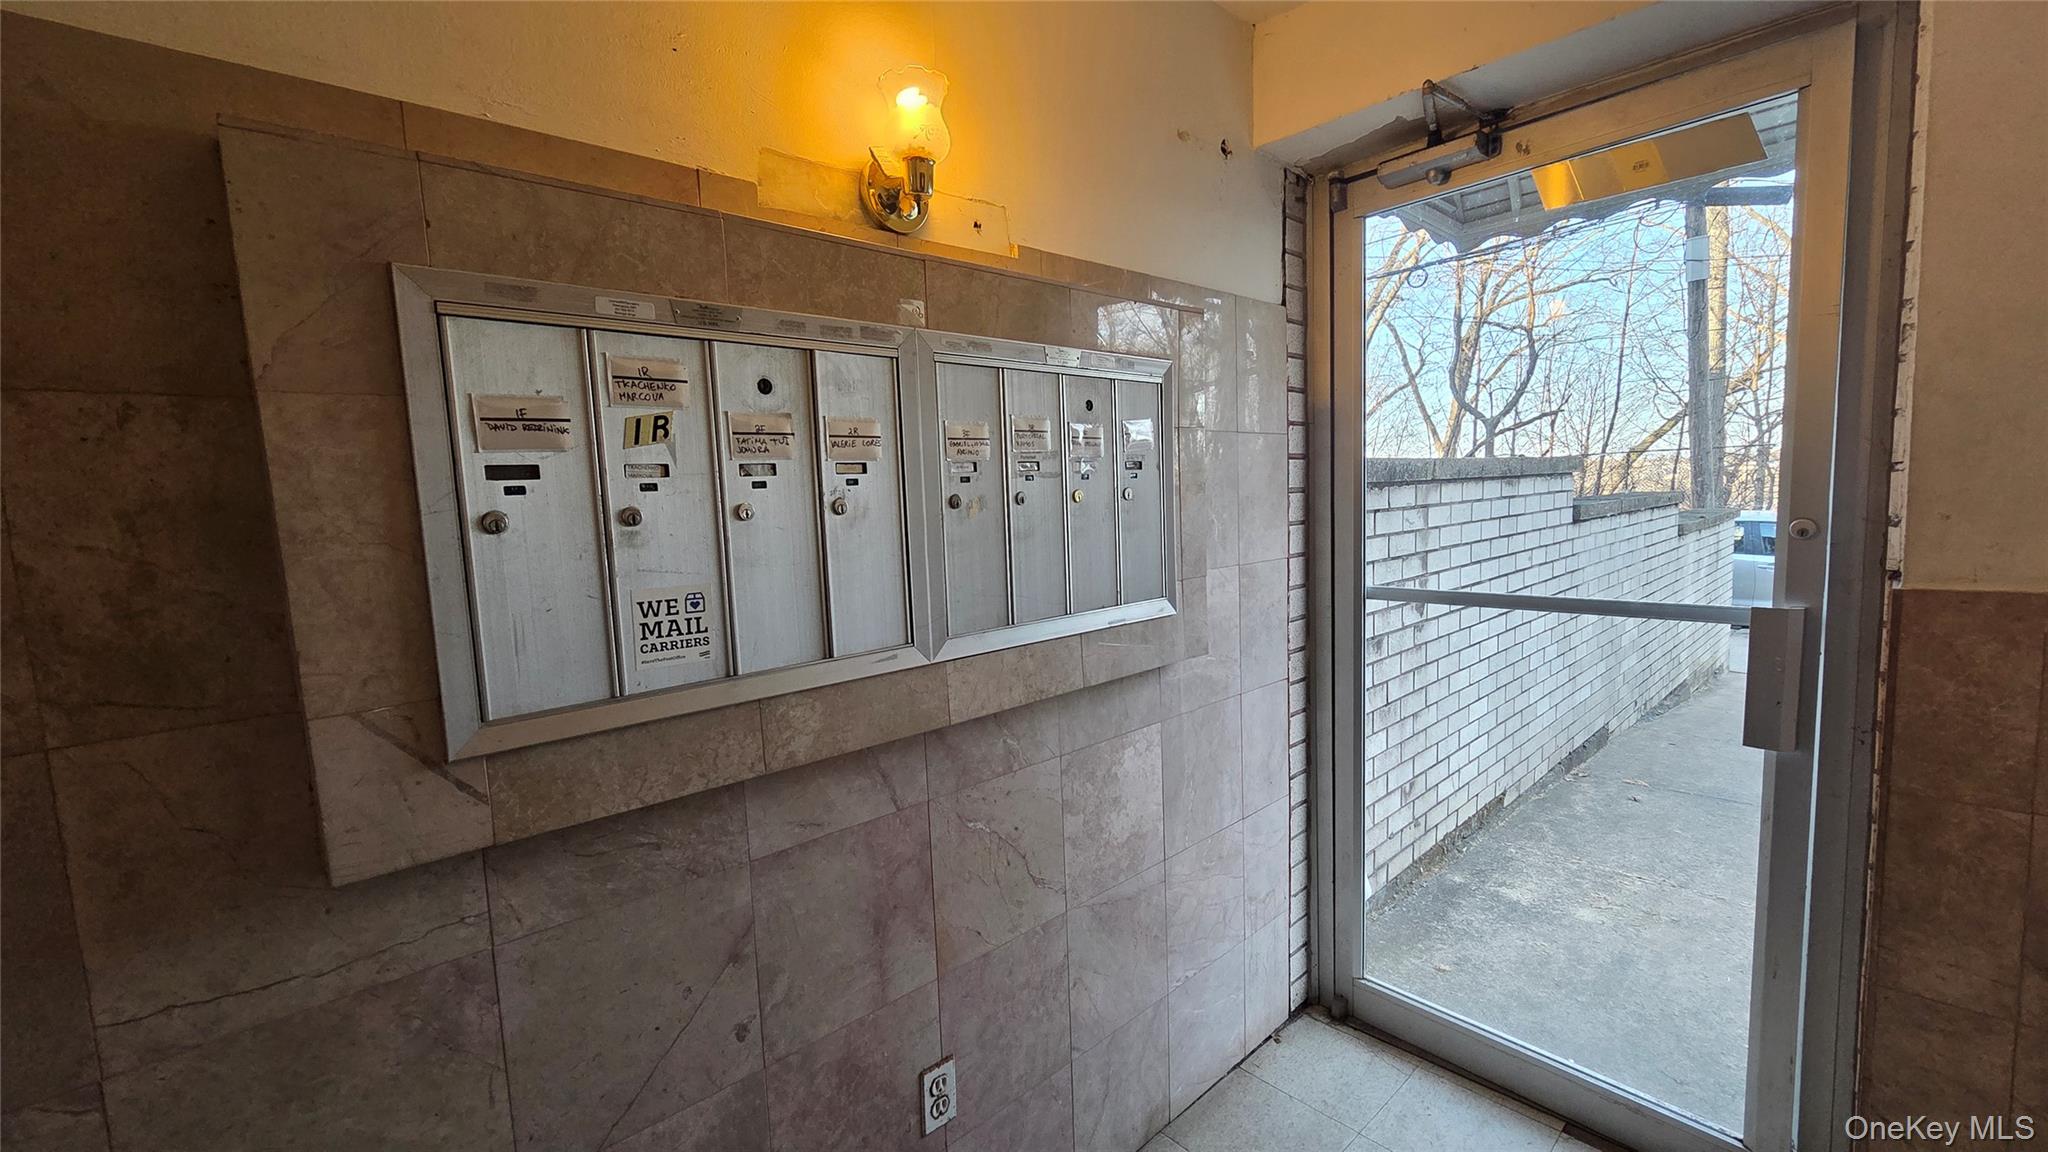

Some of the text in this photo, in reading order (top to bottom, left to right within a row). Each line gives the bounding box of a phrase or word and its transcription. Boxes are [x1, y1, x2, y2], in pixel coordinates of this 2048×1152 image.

[614, 381, 677, 391] TKACHENKO
[485, 423, 517, 432] DAVID
[636, 598, 680, 619] WE
[639, 616, 709, 641] MAIL
[640, 636, 710, 654] CARRIERS
